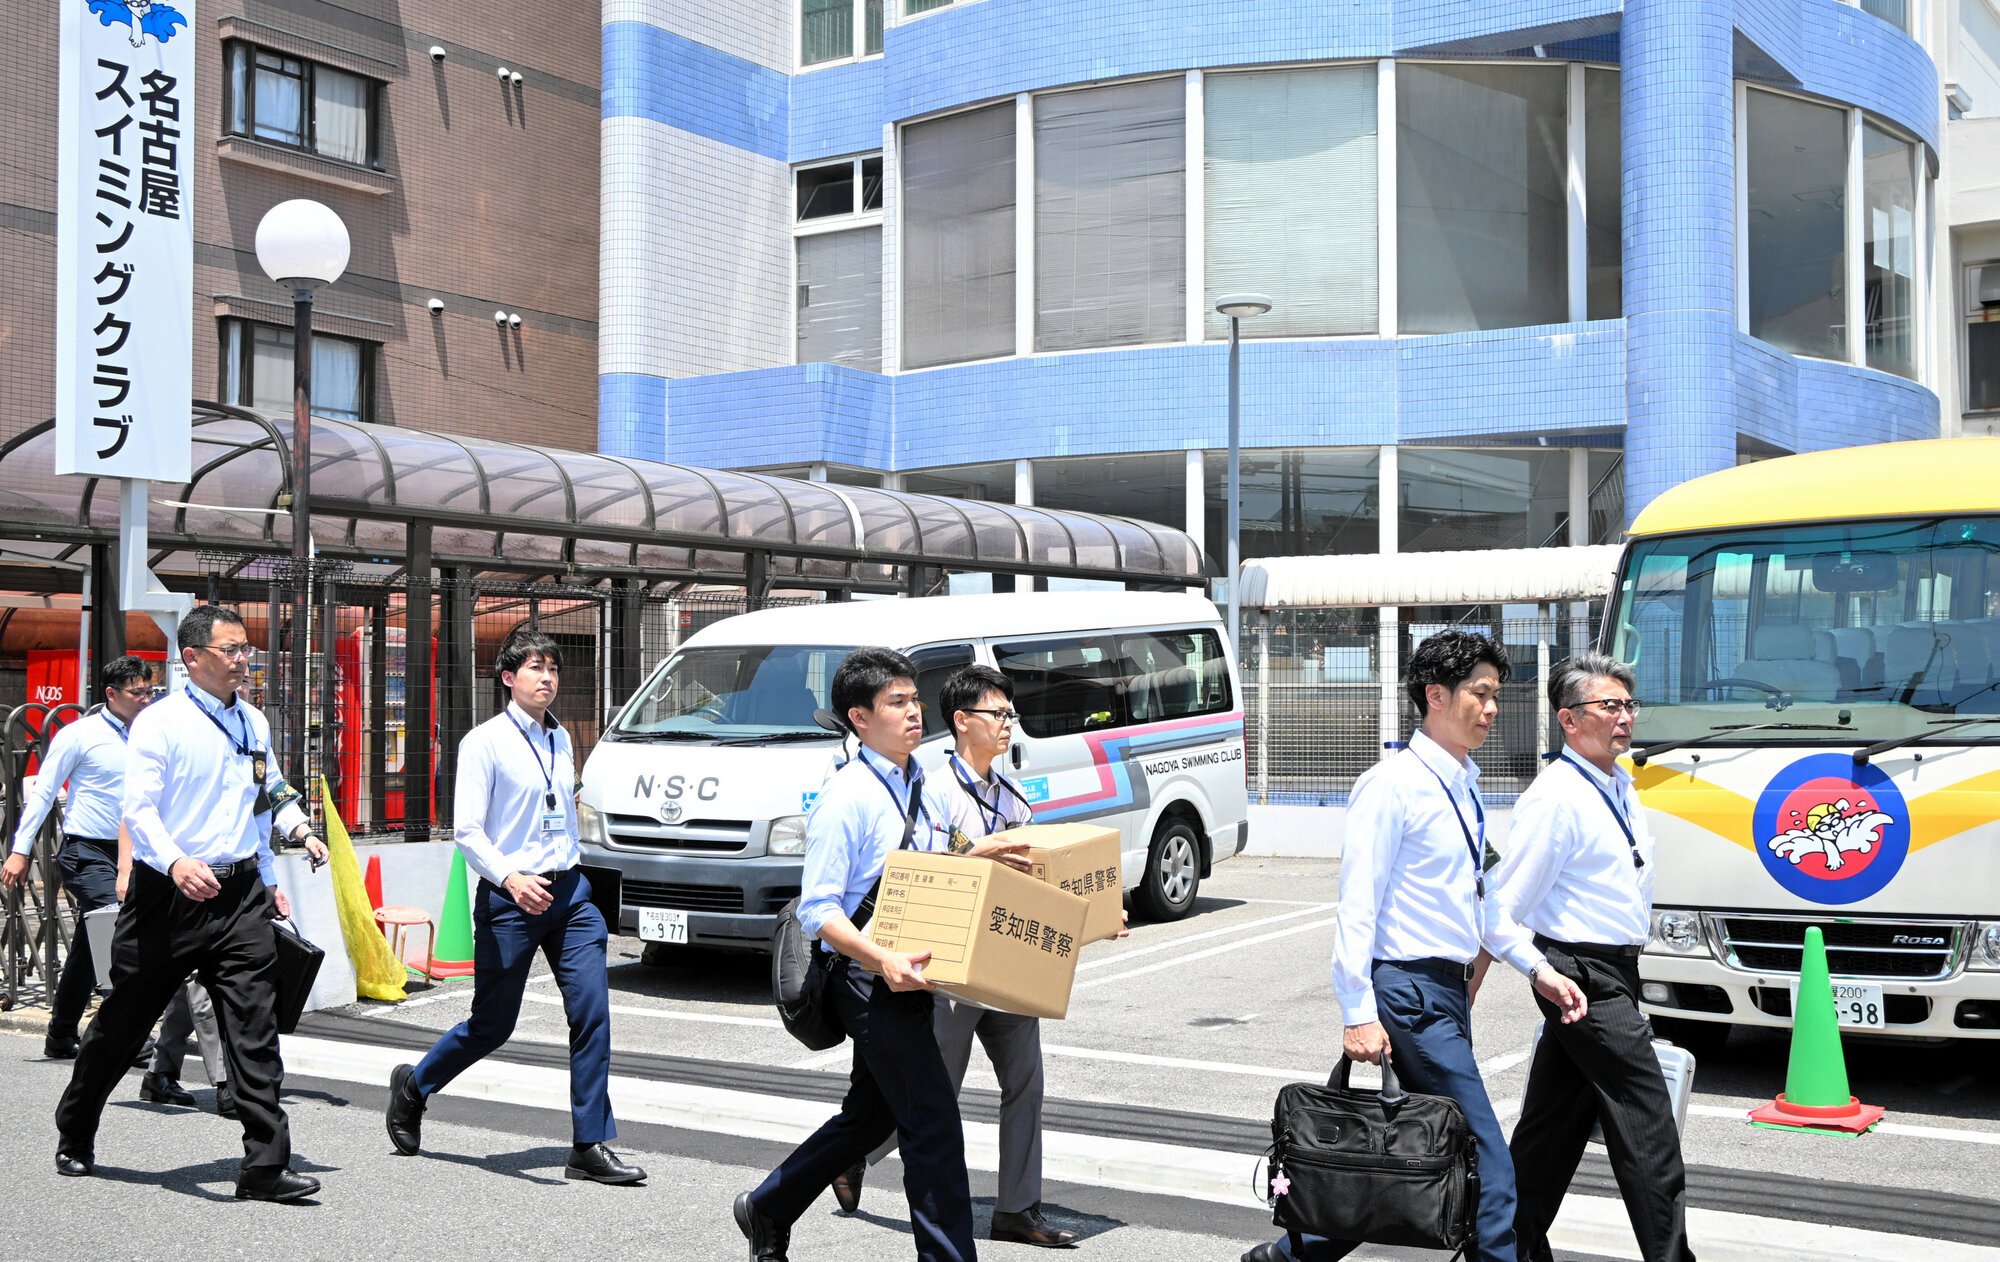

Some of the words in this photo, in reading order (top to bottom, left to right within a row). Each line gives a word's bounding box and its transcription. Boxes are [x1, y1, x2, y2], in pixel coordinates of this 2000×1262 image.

[138, 69, 181, 221] 名古屋
[93, 57, 136, 460] スイミングクラブ
[1145, 759, 1180, 776] NAGOYA
[1181, 752, 1219, 769] SWIMMING
[1220, 748, 1242, 762] CLUB
[989, 905, 1073, 958] 愛知県警察
